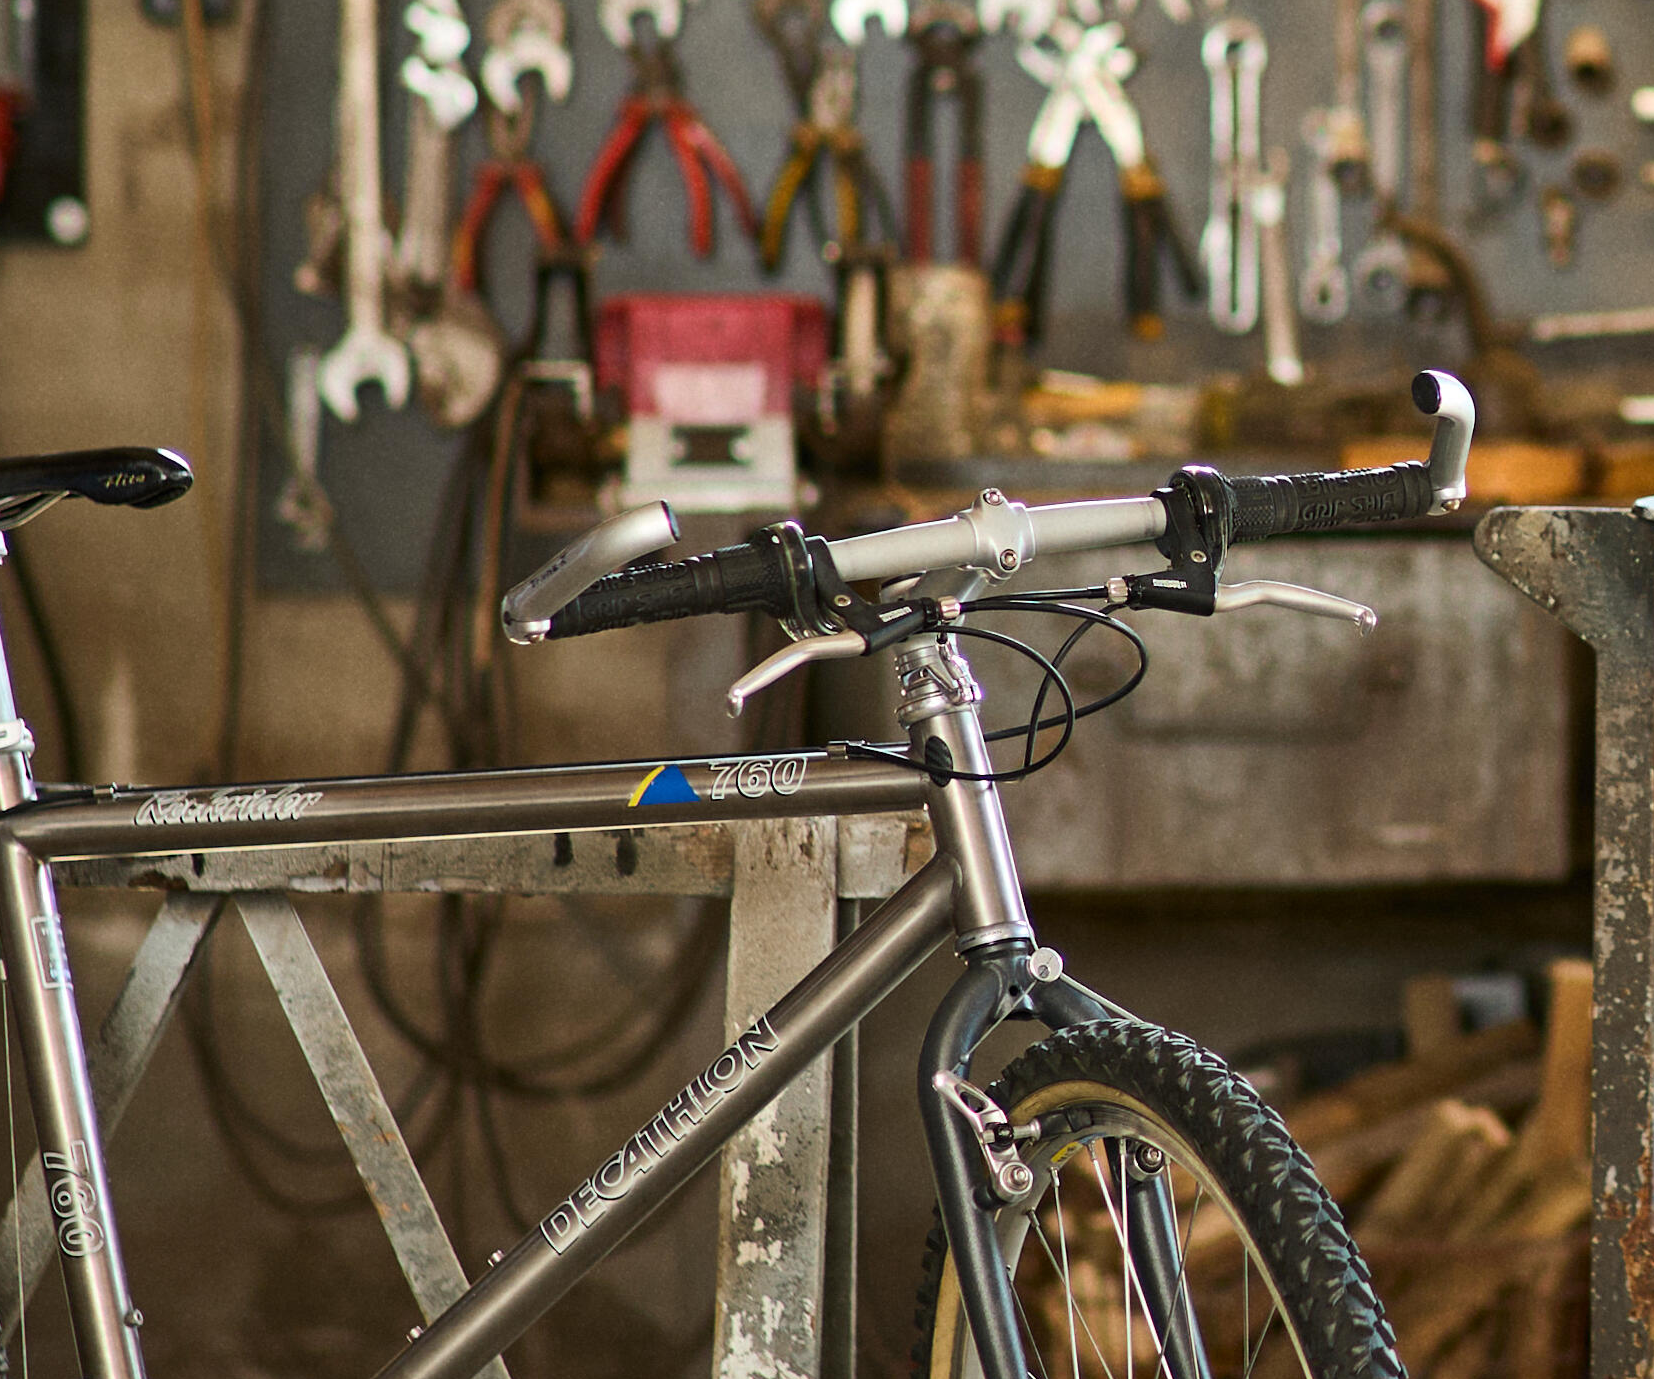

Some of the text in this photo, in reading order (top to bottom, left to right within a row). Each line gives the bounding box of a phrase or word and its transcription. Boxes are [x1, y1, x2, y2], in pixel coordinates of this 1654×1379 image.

[709, 757, 808, 800] 760
[539, 1012, 780, 1255] DECATHLON
[44, 1140, 104, 1257] 760
